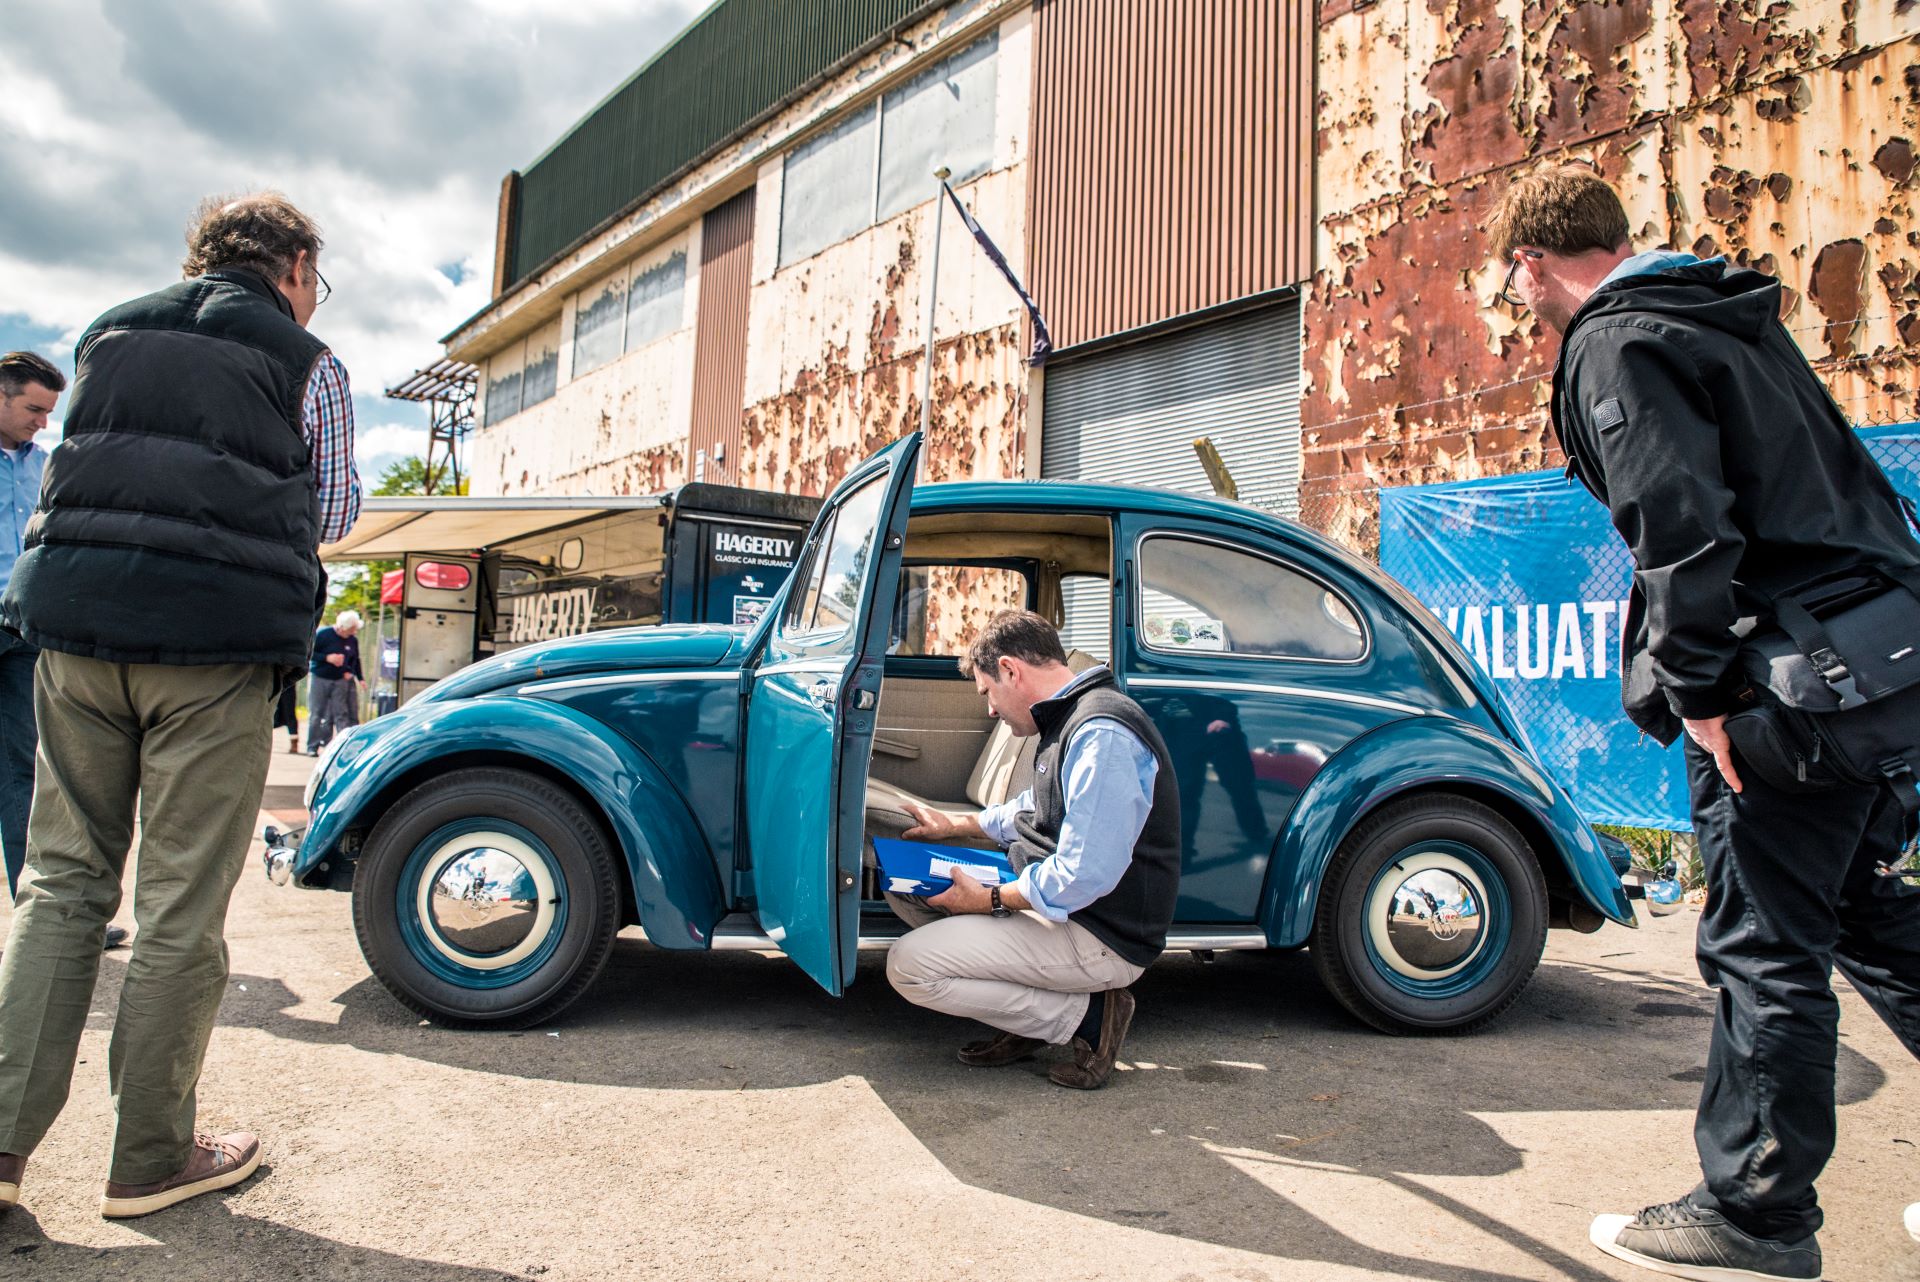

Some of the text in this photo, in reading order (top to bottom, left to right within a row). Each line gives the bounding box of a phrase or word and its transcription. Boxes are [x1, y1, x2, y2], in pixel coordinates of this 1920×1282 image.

[715, 554, 794, 569] CLASSIC CAR INSURANCE
[716, 532, 794, 557] HAGERTY
[510, 587, 597, 642] HAGERTY
[1431, 600, 1630, 680] ALUAT
